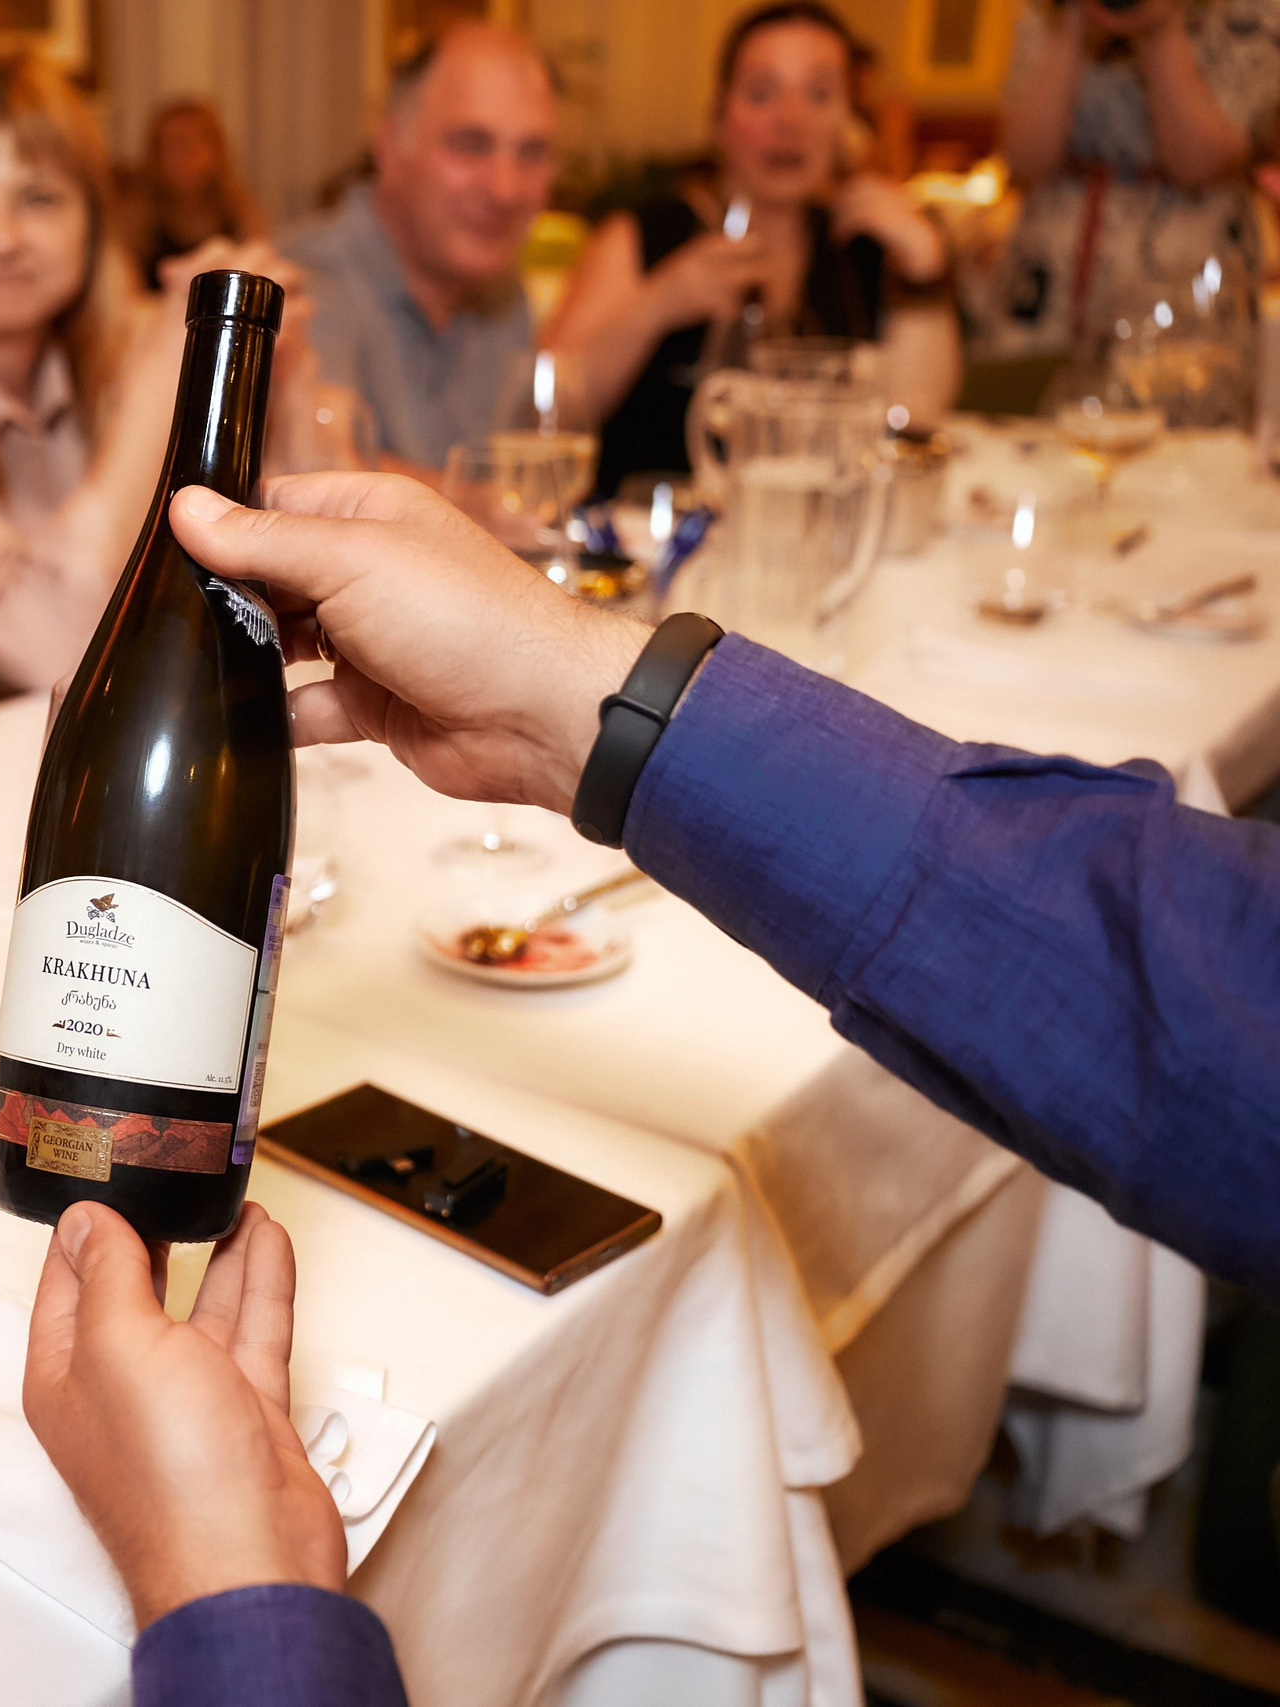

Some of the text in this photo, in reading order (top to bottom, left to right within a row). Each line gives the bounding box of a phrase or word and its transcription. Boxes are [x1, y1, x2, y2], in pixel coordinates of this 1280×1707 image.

[66, 921, 135, 945] Dugladze
[42, 955, 151, 990] KRAKHUNA
[66, 1019, 103, 1036] 2020
[57, 1042, 107, 1061] Dry white
[43, 1135, 93, 1152] GEORGIAN
[53, 1148, 79, 1161] WINE
